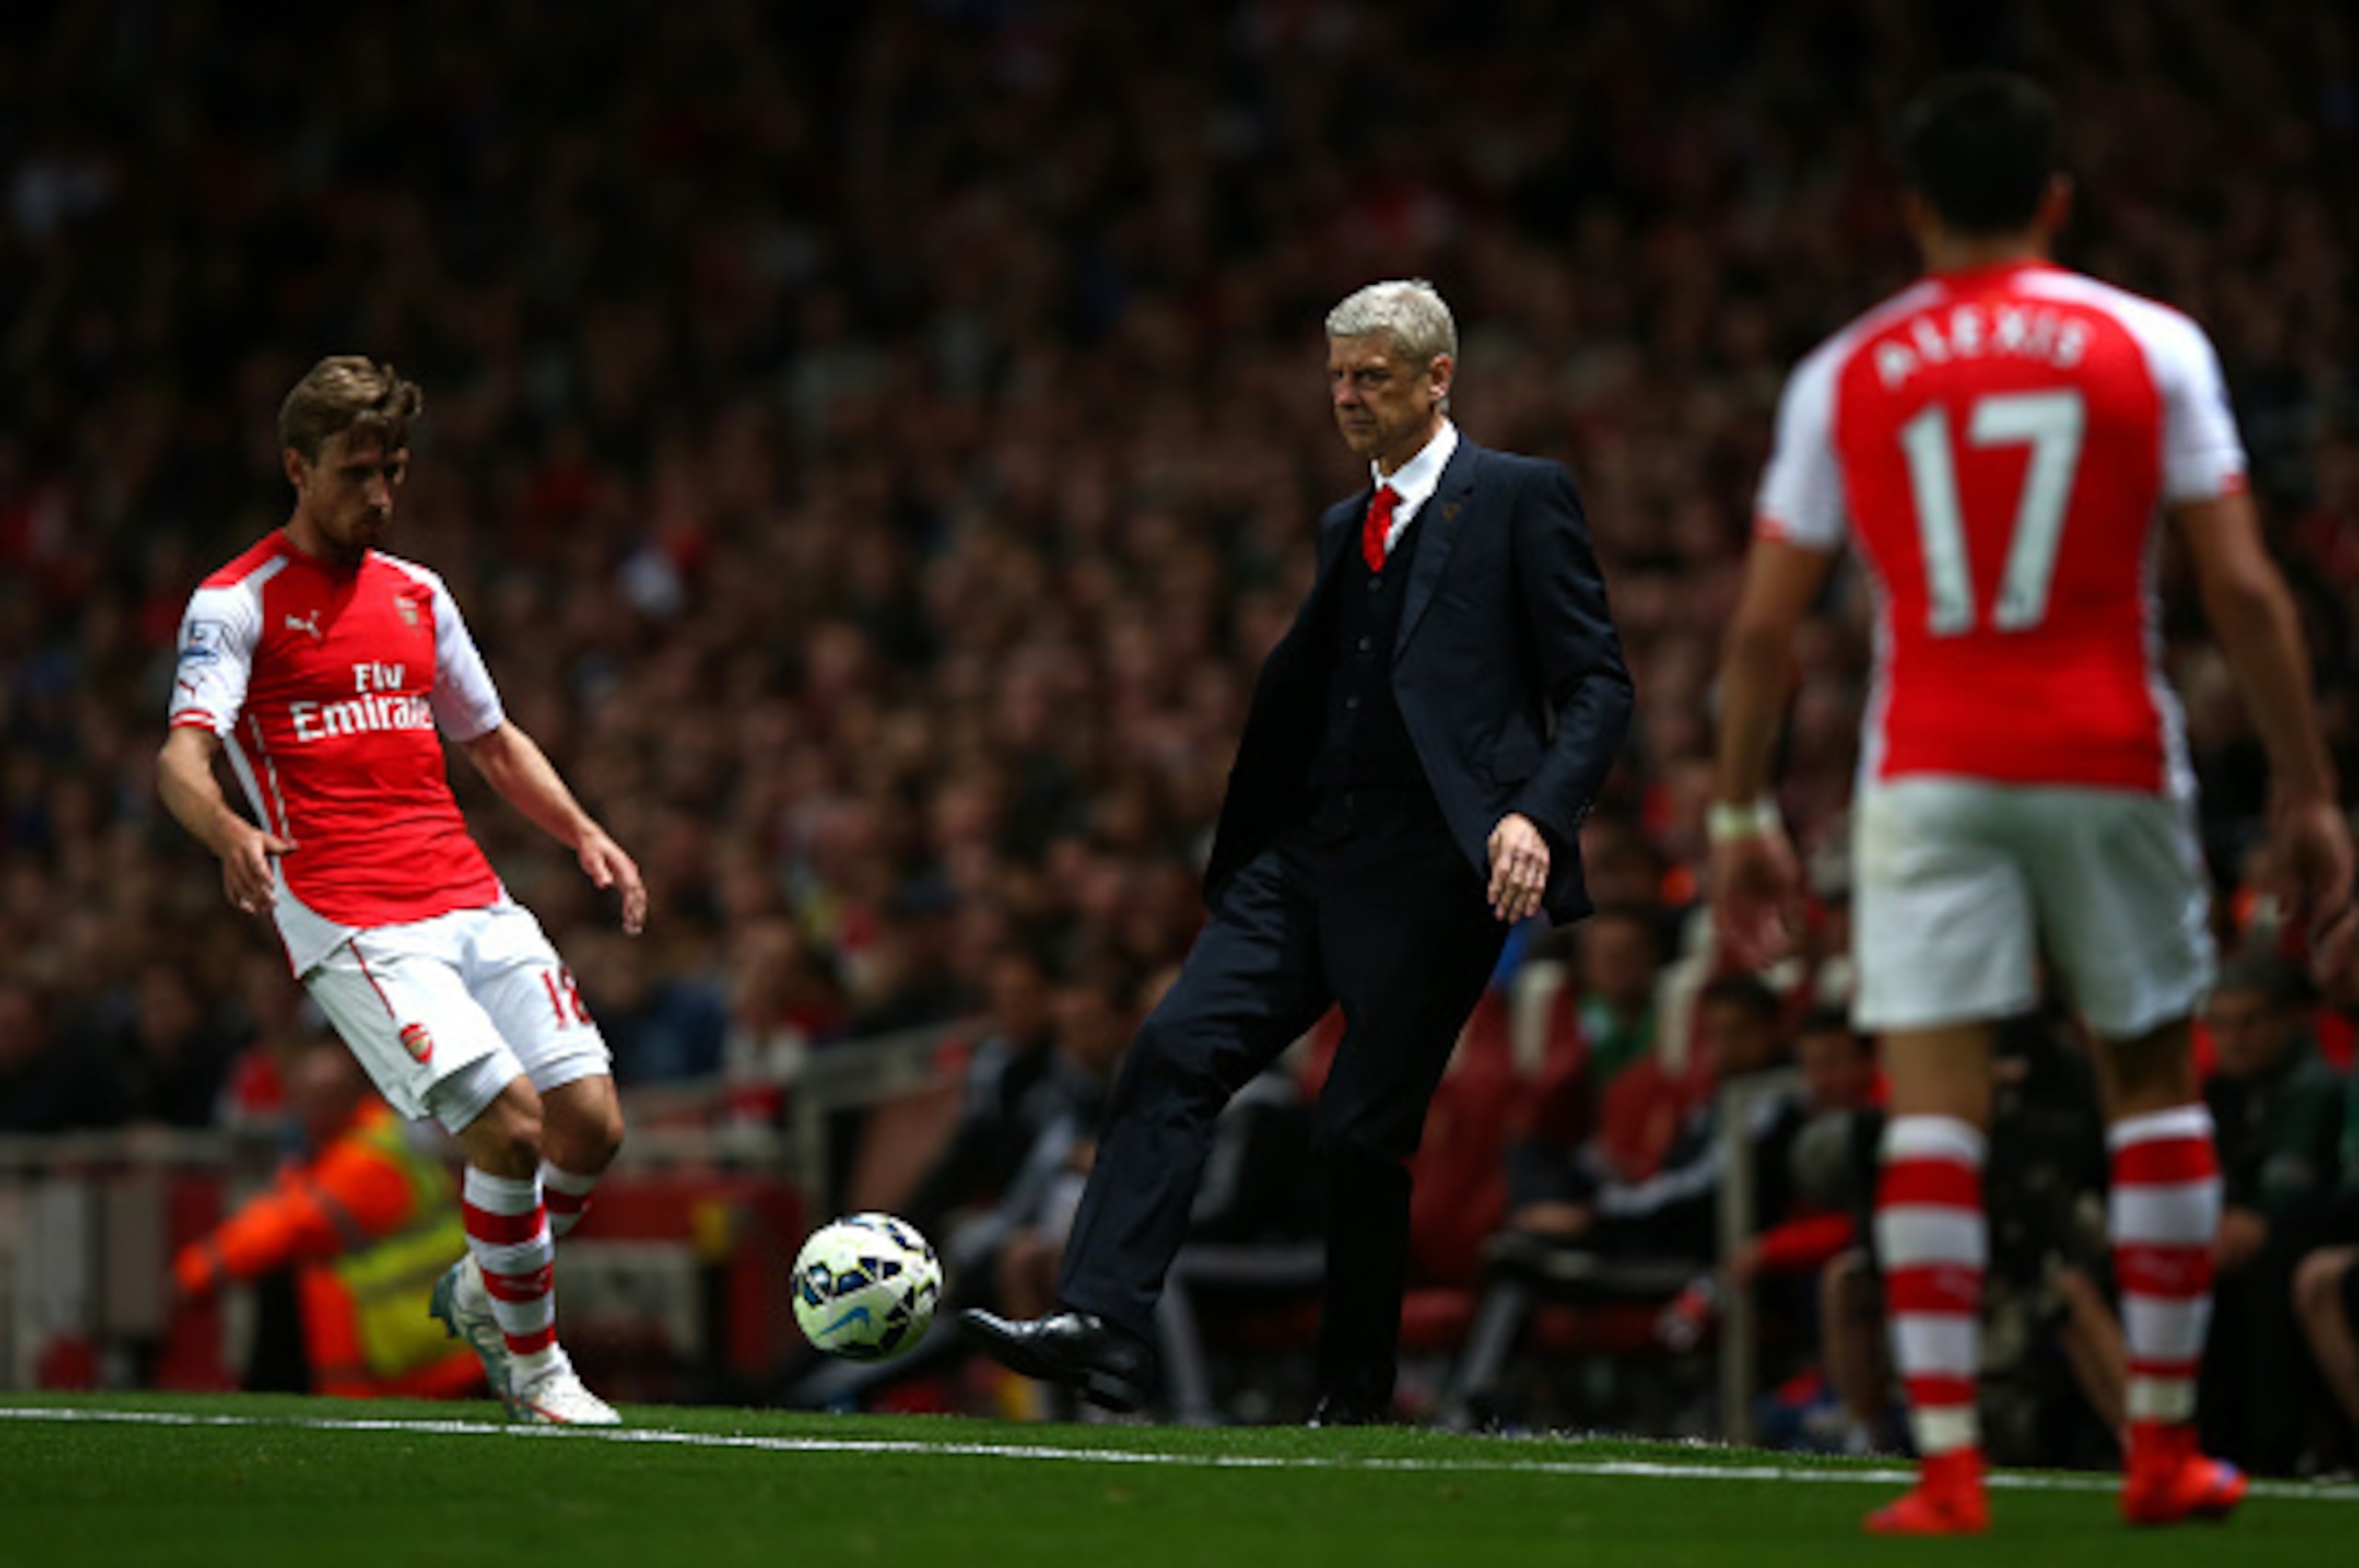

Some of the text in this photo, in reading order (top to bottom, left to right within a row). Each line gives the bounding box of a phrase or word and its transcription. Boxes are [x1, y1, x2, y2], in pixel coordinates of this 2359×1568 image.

[1876, 306, 2088, 389] ALEXIS
[1900, 389, 2084, 634] 17
[352, 661, 405, 692] Fly
[289, 693, 434, 743] Emirate
